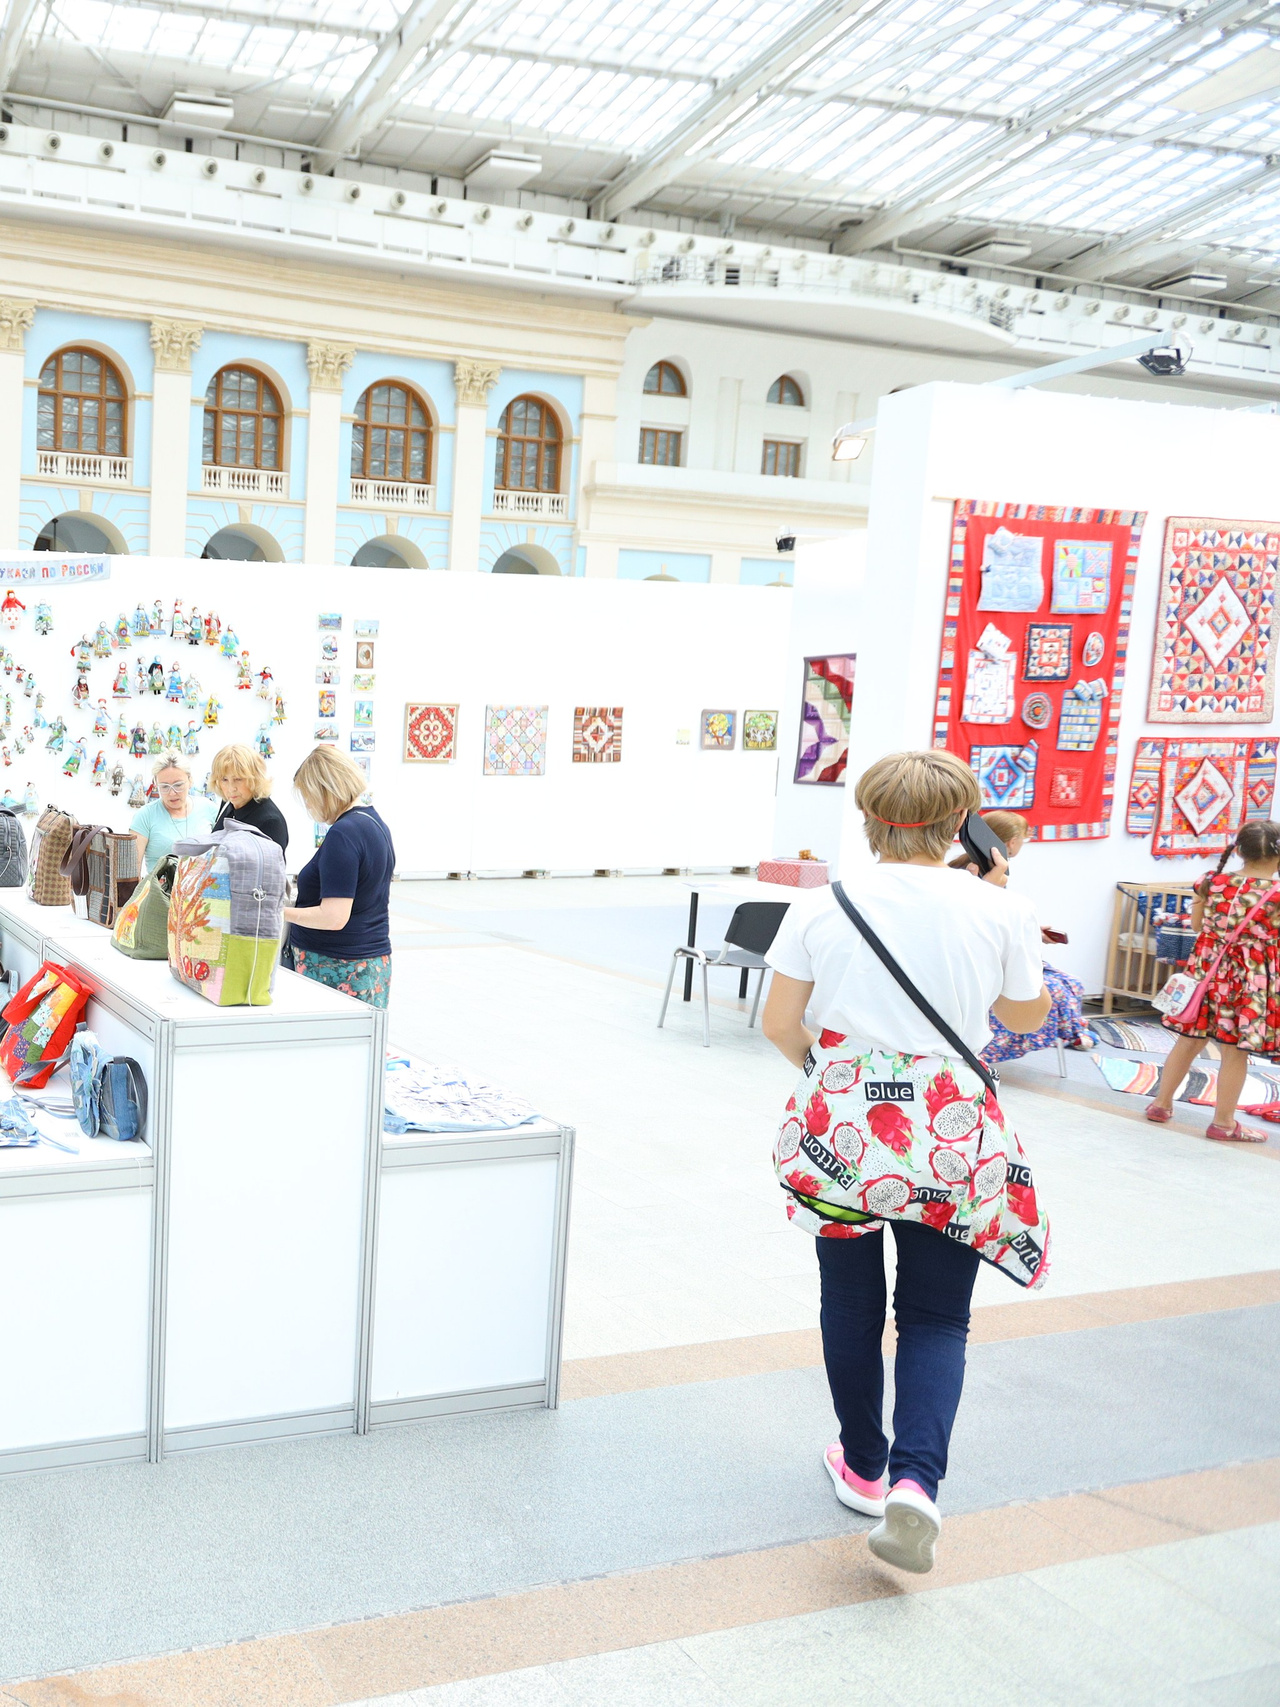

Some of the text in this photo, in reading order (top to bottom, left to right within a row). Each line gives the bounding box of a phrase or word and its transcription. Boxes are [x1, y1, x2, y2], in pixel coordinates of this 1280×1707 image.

[41, 566, 56, 578] ПО
[61, 562, 104, 577] РОССИИ
[866, 1082, 913, 1100] blue
